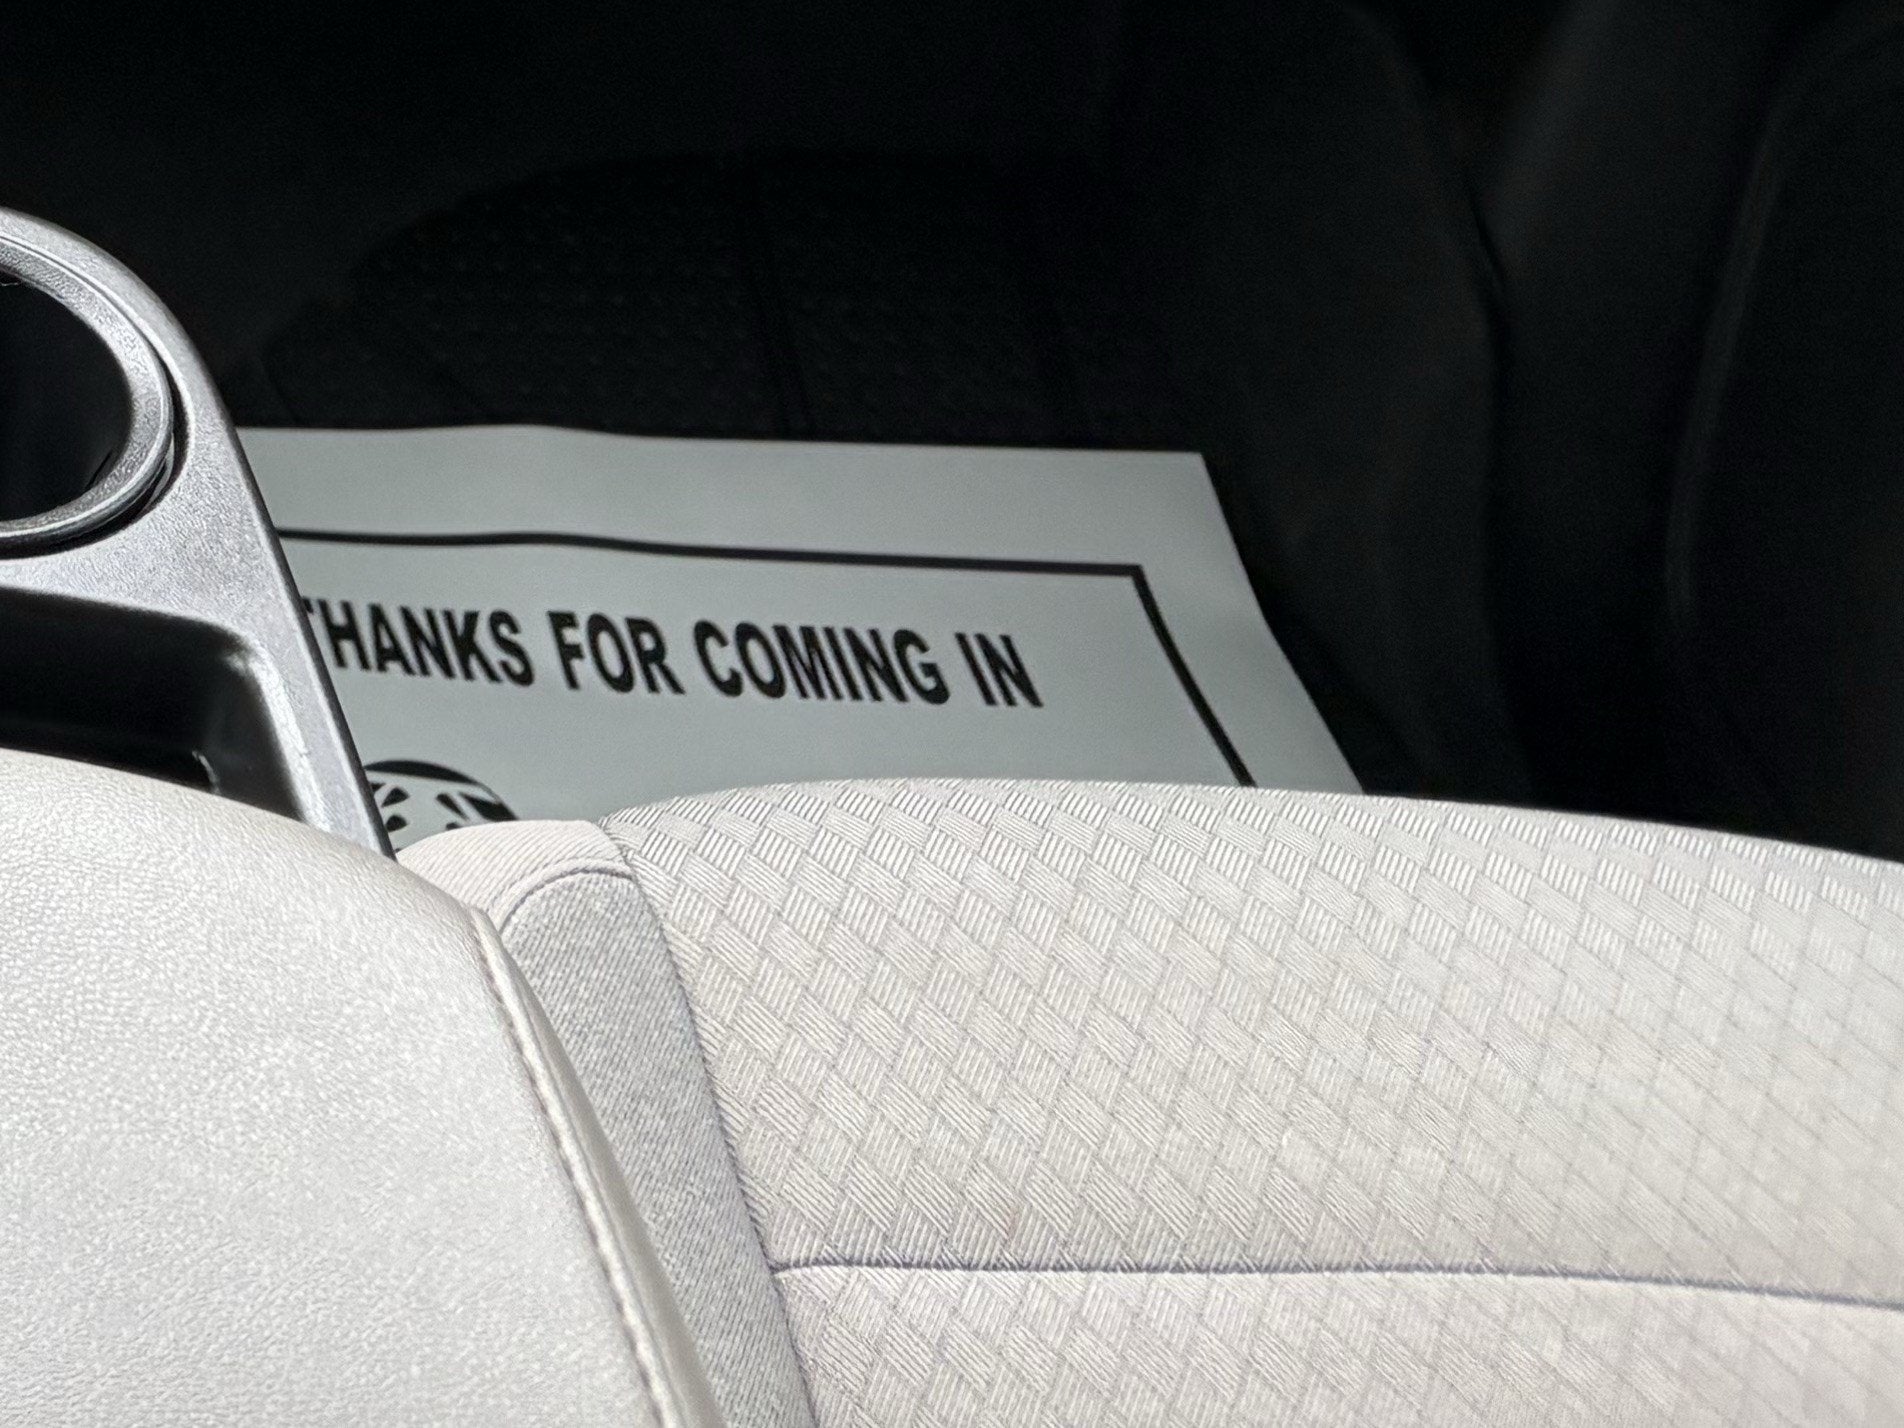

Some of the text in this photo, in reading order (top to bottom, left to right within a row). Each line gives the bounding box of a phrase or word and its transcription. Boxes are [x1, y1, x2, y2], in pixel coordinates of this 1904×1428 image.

[300, 594, 1044, 709] HANKS FOR COMING IN
